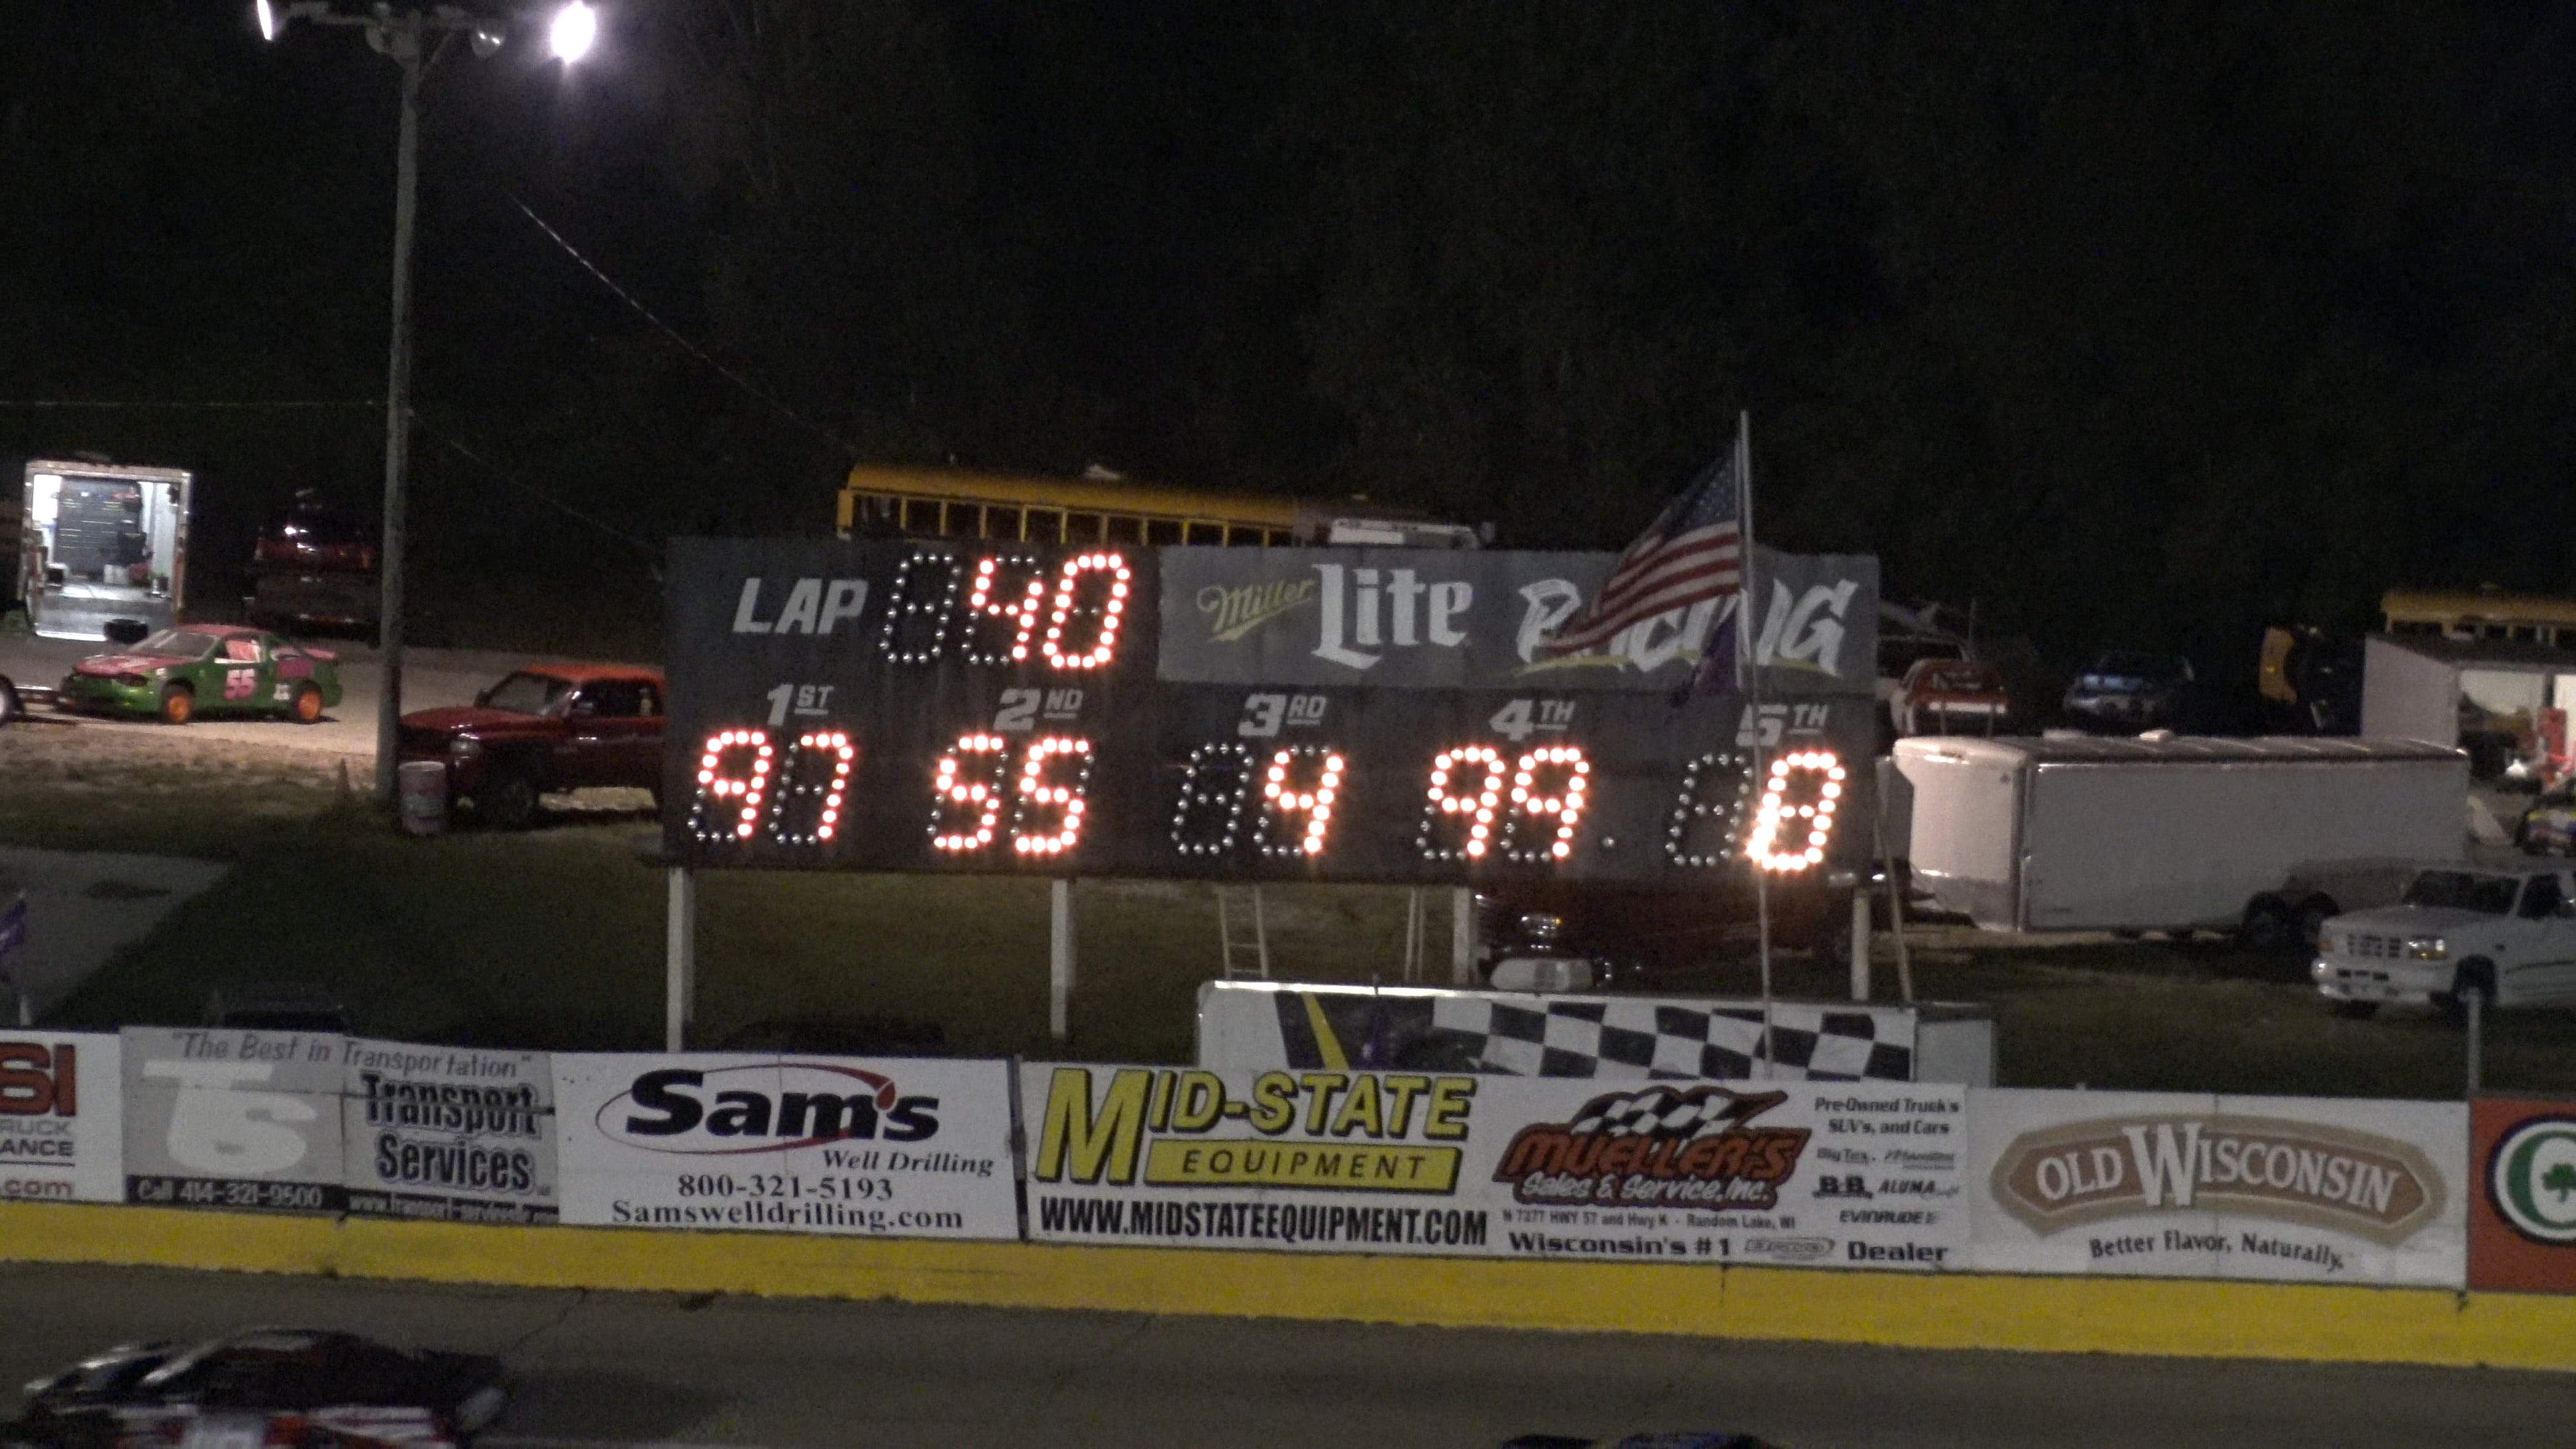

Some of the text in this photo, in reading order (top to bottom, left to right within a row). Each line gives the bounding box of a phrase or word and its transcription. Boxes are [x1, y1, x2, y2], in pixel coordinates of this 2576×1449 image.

[732, 578, 868, 635] LAP
[971, 552, 1131, 668] 40
[1197, 578, 1316, 642] Miller
[1310, 564, 1474, 669] Lite
[993, 688, 1083, 731] 2ND
[1237, 693, 1327, 737] 3RD
[1488, 698, 1575, 742] 4TH
[696, 730, 853, 839] 97
[934, 734, 1089, 853] 55
[1264, 749, 1344, 856] 4
[1426, 746, 1590, 859] 99
[1746, 751, 1846, 871] 8
[239, 1032, 297, 1060] Best
[308, 1040, 332, 1062] in
[360, 1072, 537, 1134] Transport
[1880, 1121, 1911, 1134] and
[1913, 1121, 1949, 1134] Cars
[377, 1132, 533, 1191] Services
[822, 1149, 995, 1178] Well Drilling
[1182, 1148, 1426, 1181] EQUIPMENT
[2036, 1122, 2399, 1214] OLD WISCONSIN
[138, 1179, 174, 1201] Call
[678, 1173, 894, 1202] 800-321-5193
[1521, 1171, 1591, 1198] Sales
[611, 1199, 964, 1232] Samswelldrilling.com
[1040, 1196, 1488, 1246] WWW.MIDSTATEEQUIPMENT.COM
[1602, 1213, 1623, 1226] and
[1628, 1213, 1654, 1230] Hwy
[1687, 1214, 1738, 1228] Random
[1508, 1232, 1686, 1255] Wisconsin's
[1848, 1241, 1947, 1261] Dealer
[2089, 1236, 2155, 1258] Better
[2163, 1230, 2232, 1253] Flavor,
